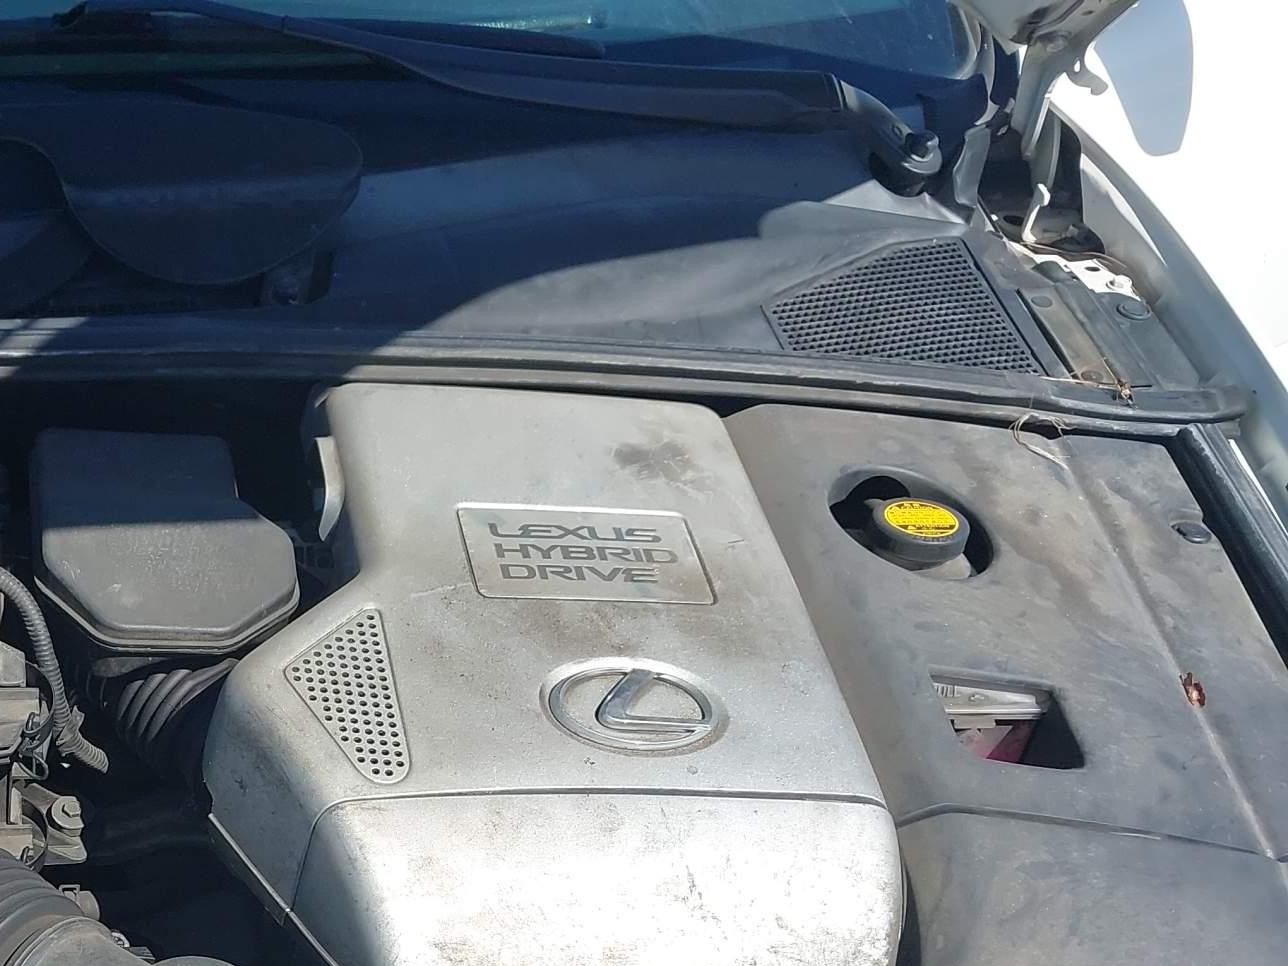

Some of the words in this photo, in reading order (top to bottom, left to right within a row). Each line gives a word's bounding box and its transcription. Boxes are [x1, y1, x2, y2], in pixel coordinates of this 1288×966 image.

[488, 522, 662, 543] LEXUS
[493, 543, 679, 564] HYBRID
[500, 564, 660, 584] DRIVE
